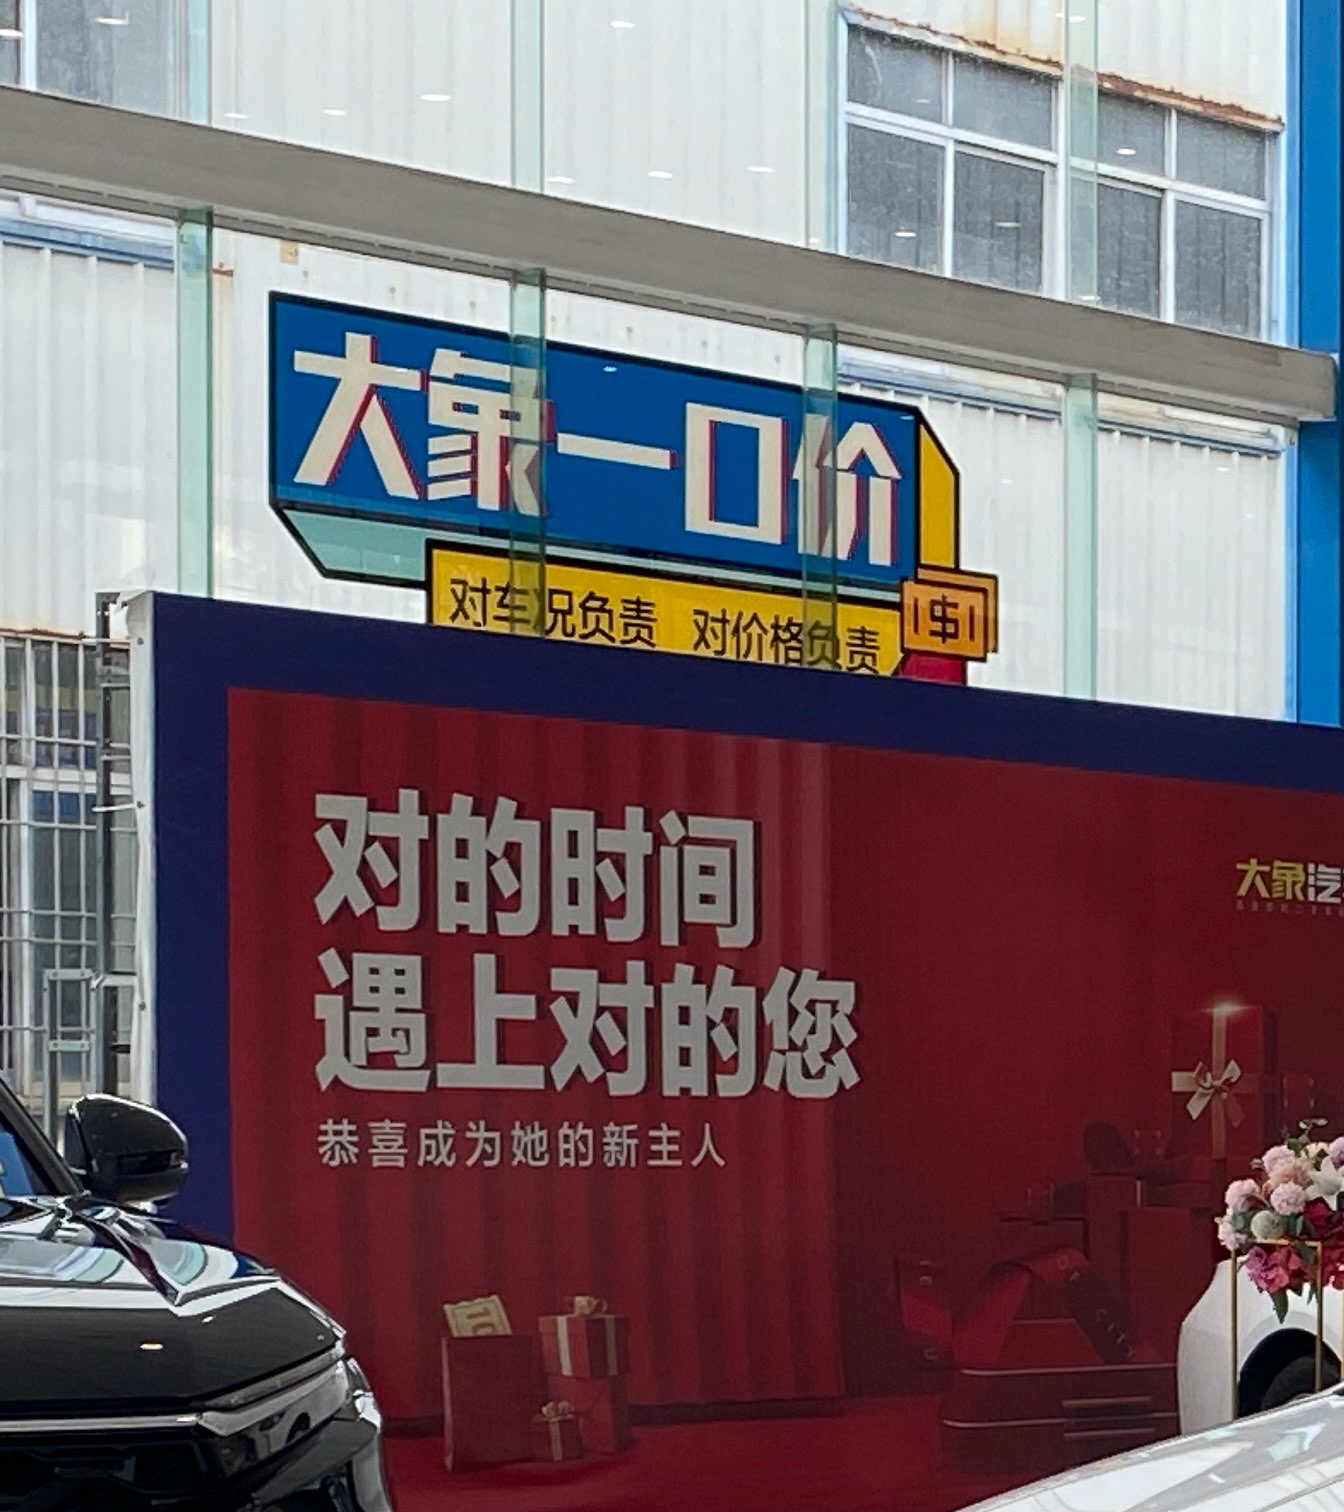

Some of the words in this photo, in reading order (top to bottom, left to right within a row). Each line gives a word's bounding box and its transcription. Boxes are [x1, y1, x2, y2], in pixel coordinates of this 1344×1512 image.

[293, 331, 902, 566] 大象一口价
[449, 577, 658, 646] 对车况负责
[692, 608, 881, 674] 对价格负责
[314, 788, 758, 949] 对的时间
[314, 947, 861, 1100] 遇上对的您
[317, 1119, 727, 1169] 恭喜成为她的新主人
